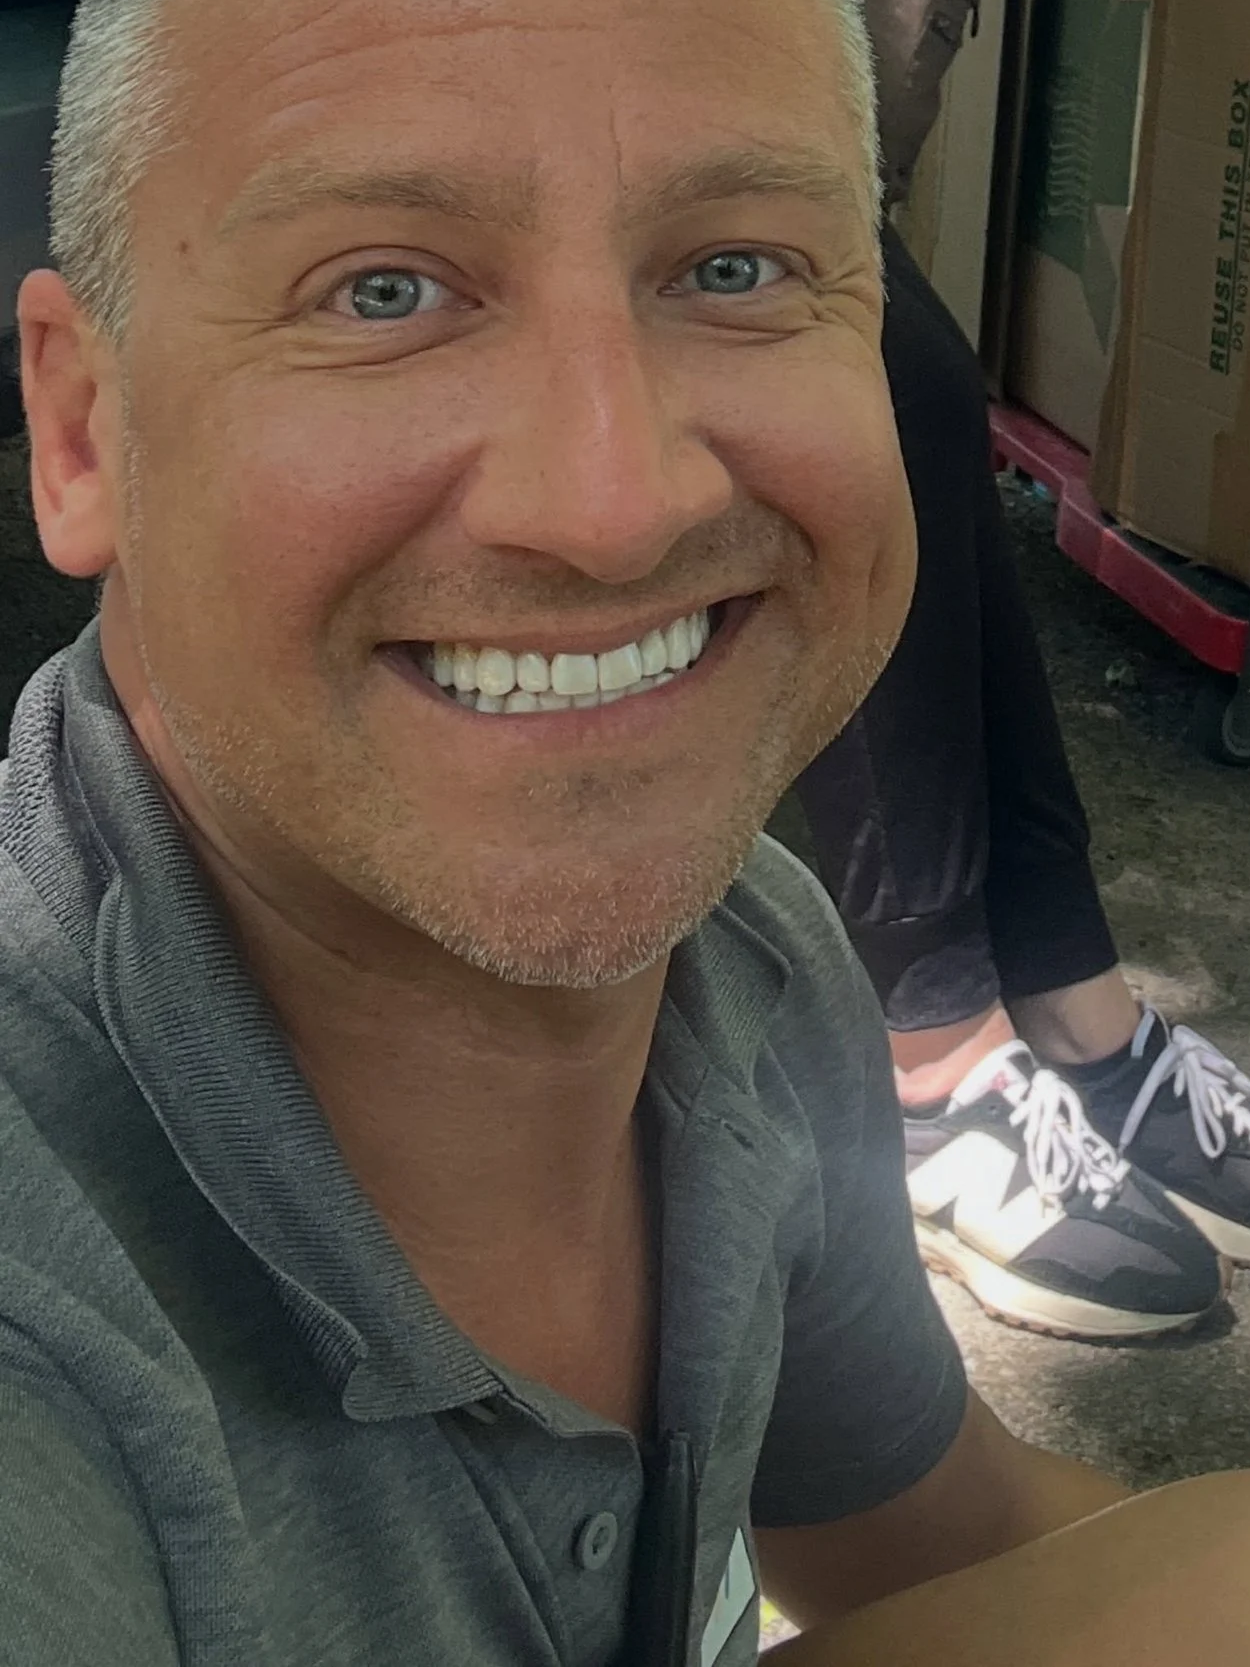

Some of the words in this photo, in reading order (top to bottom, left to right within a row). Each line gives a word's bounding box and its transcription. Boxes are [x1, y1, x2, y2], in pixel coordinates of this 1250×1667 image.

[1226, 79, 1250, 150] BOX
[1217, 164, 1242, 241] THIS
[1209, 257, 1233, 374] REUSE
[1234, 270, 1249, 314] NOT
[1231, 320, 1245, 353] DO
